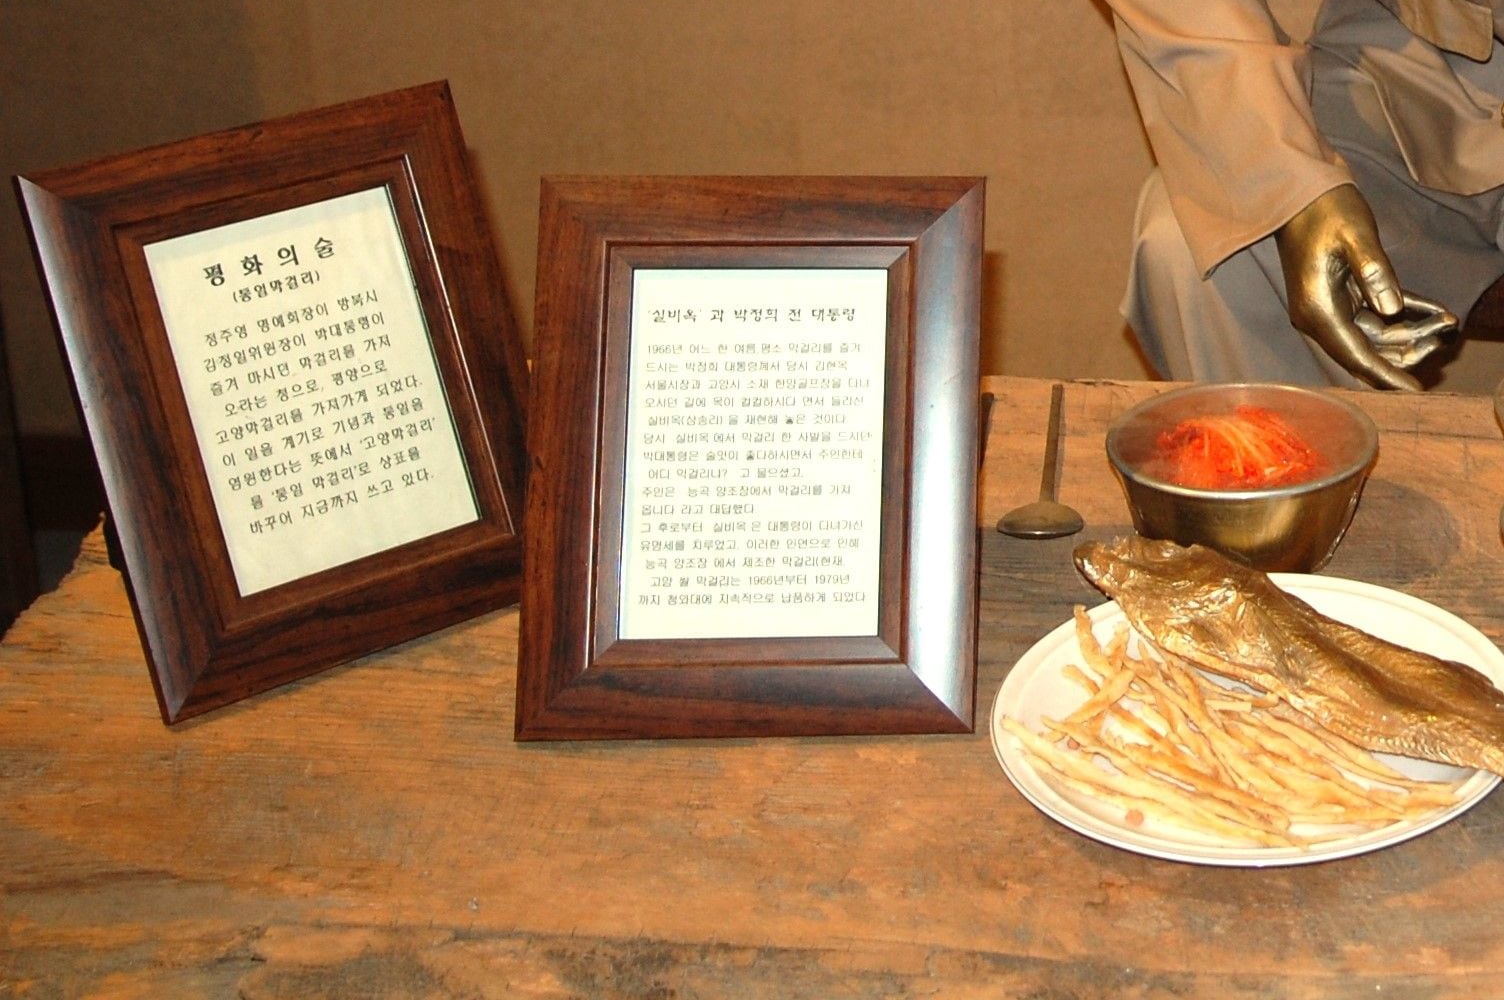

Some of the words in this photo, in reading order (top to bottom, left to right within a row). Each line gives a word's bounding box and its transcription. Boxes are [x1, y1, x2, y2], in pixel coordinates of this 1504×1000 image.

[232, 269, 320, 303] (통일막걸리)
[204, 323, 248, 347] 정주영
[256, 301, 329, 333] 명예회장이
[203, 332, 306, 373] 김정일위원장이
[210, 376, 239, 396] 즐겨
[246, 361, 290, 384] 마시던
[298, 343, 355, 369] 막걸리를
[362, 333, 391, 352] 가져
[215, 407, 303, 444] 고양막걸리를
[311, 388, 368, 416] 가져가게
[224, 395, 267, 417] 오라는
[330, 359, 387, 386] 평양으로
[221, 451, 236, 466] 이
[243, 441, 273, 461] 일을
[281, 426, 324, 449] 계기로
[331, 411, 374, 434] 기념과
[382, 396, 423, 420] 통일을
[309, 442, 352, 467] 뜻에서
[250, 493, 263, 510] 를
[379, 445, 420, 470] 상표를
[249, 510, 293, 534] 바꾸어
[301, 489, 358, 518] 지금까지
[366, 478, 394, 498] 쓰고
